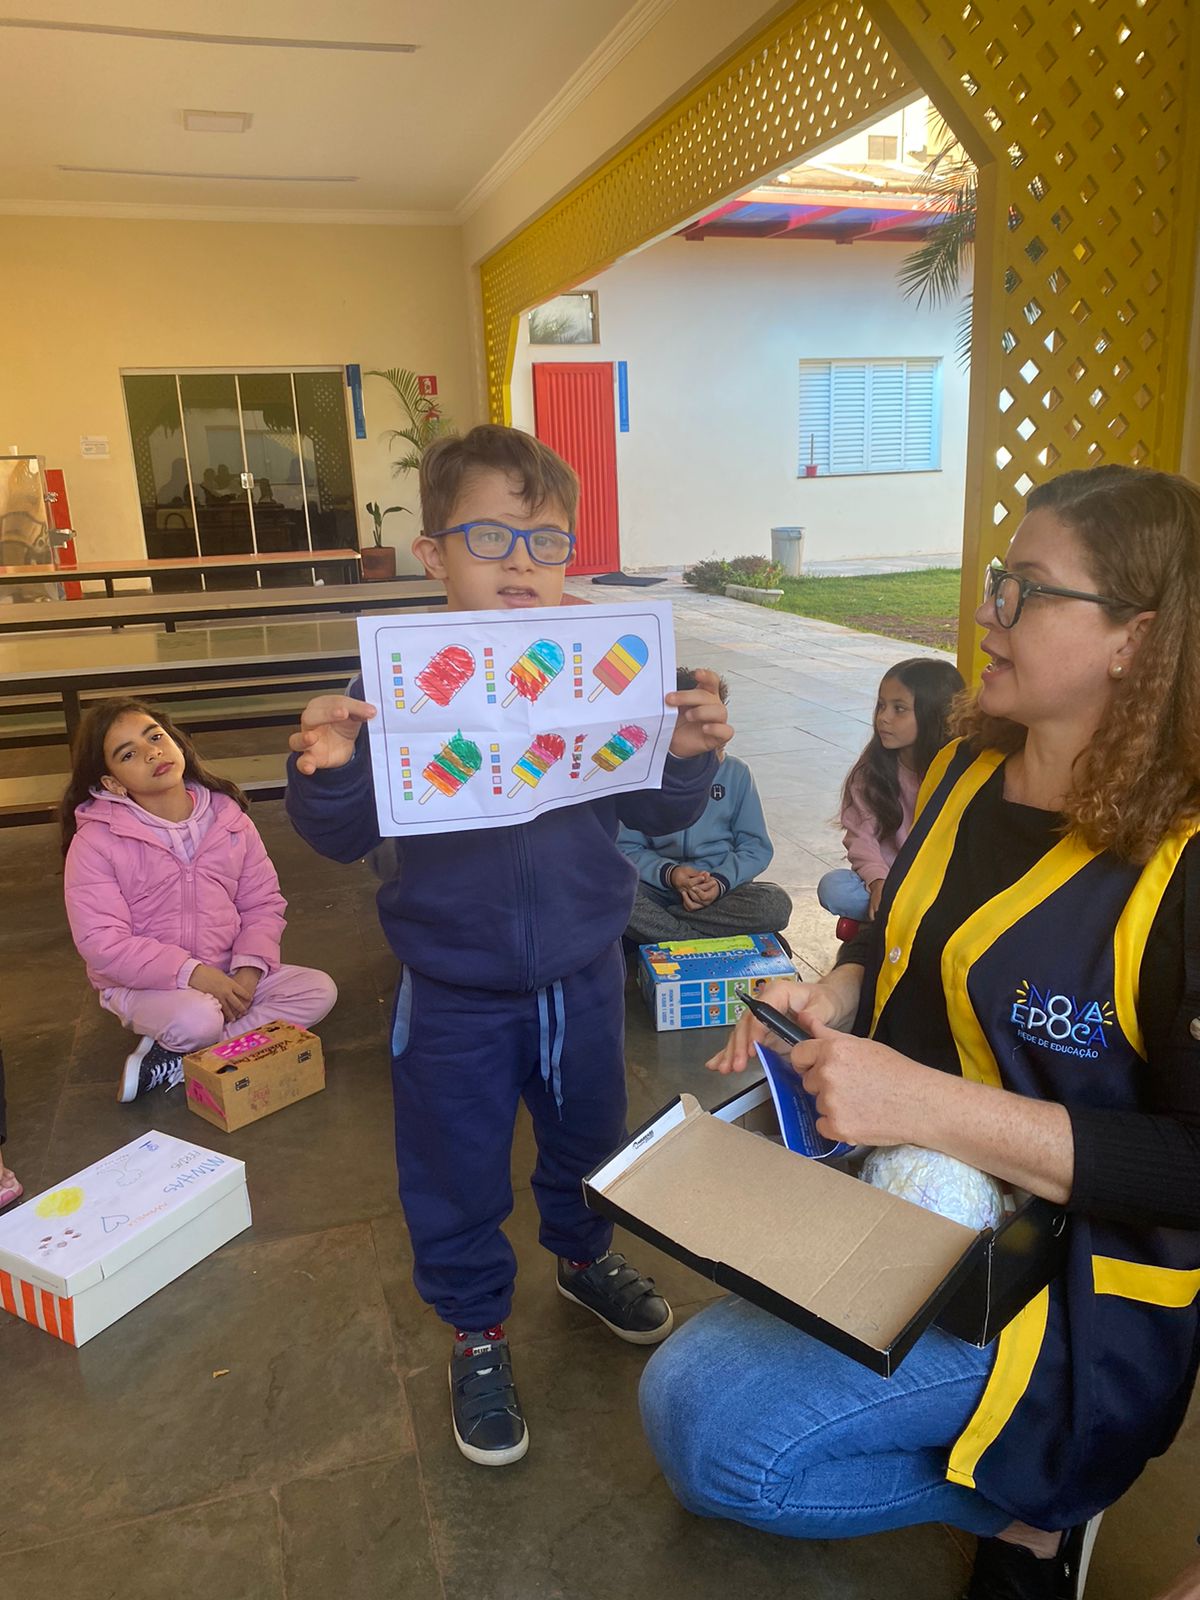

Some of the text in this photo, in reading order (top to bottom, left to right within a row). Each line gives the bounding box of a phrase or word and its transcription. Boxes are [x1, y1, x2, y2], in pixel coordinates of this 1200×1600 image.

[1028, 984, 1104, 1023] NOVA
[1038, 1037, 1049, 1048] DE
[1050, 1042, 1099, 1059] EDUCAÇÃO
